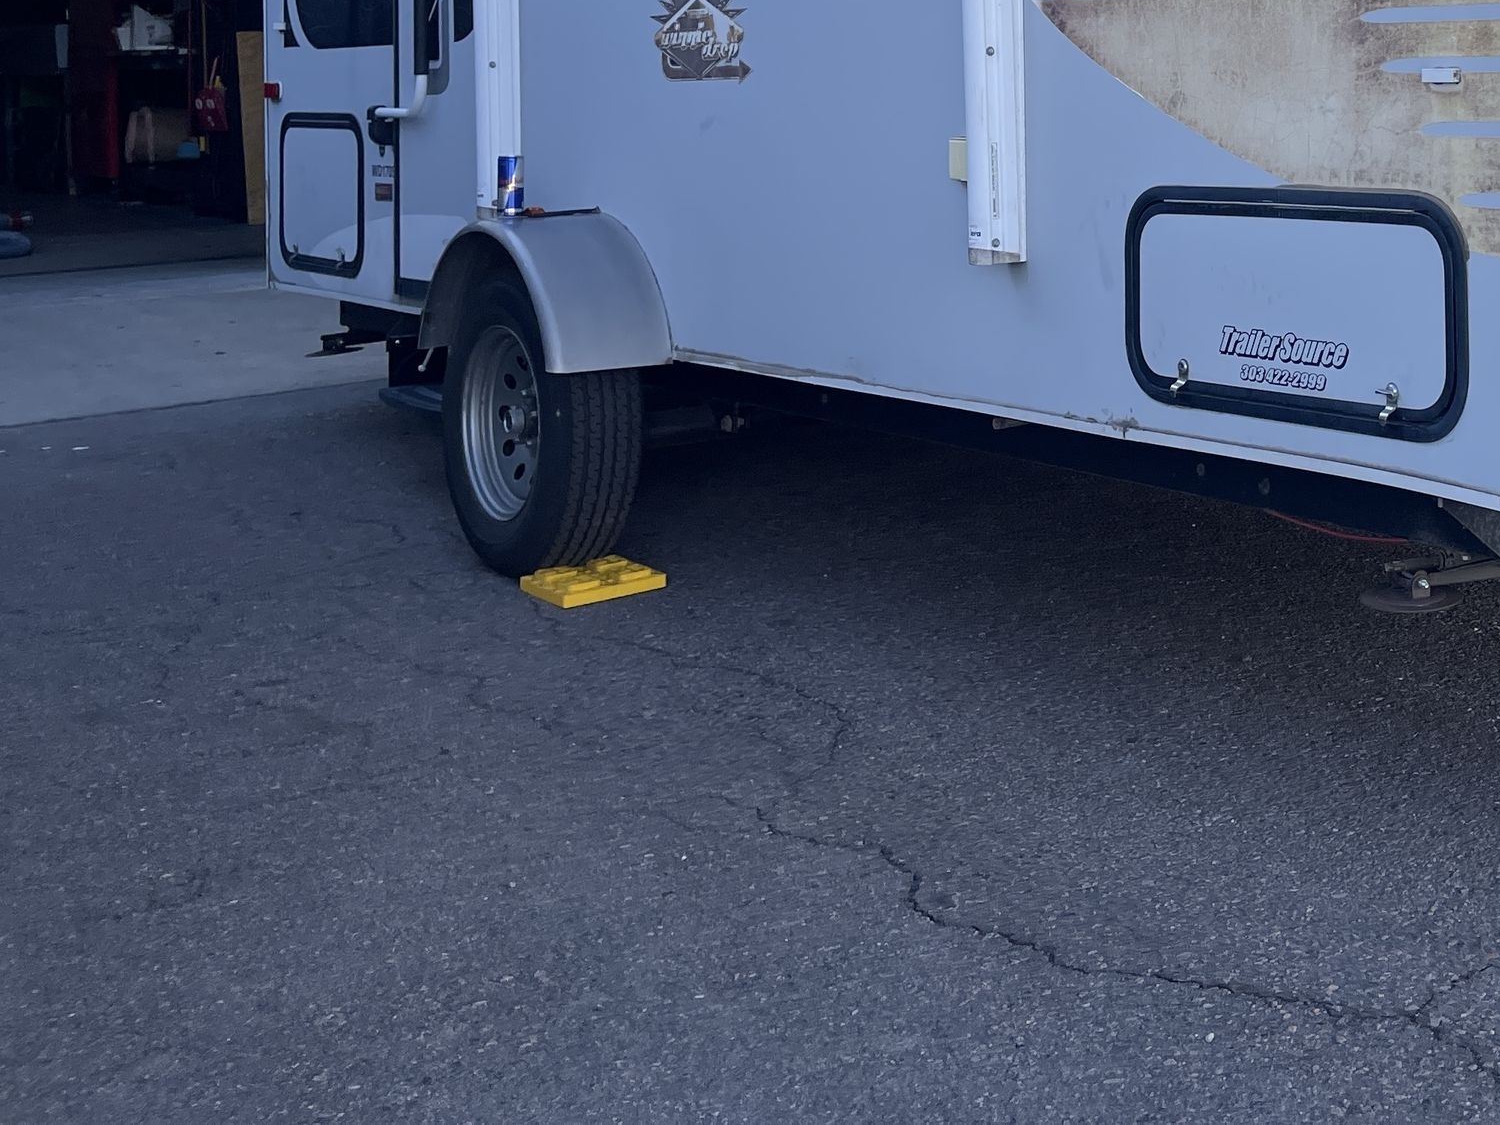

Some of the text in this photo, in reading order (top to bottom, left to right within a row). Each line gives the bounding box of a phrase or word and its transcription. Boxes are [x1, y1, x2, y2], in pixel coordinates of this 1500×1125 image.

[1219, 325, 1350, 370] Trailer Source
[1240, 364, 1327, 391] 303 422-2999
